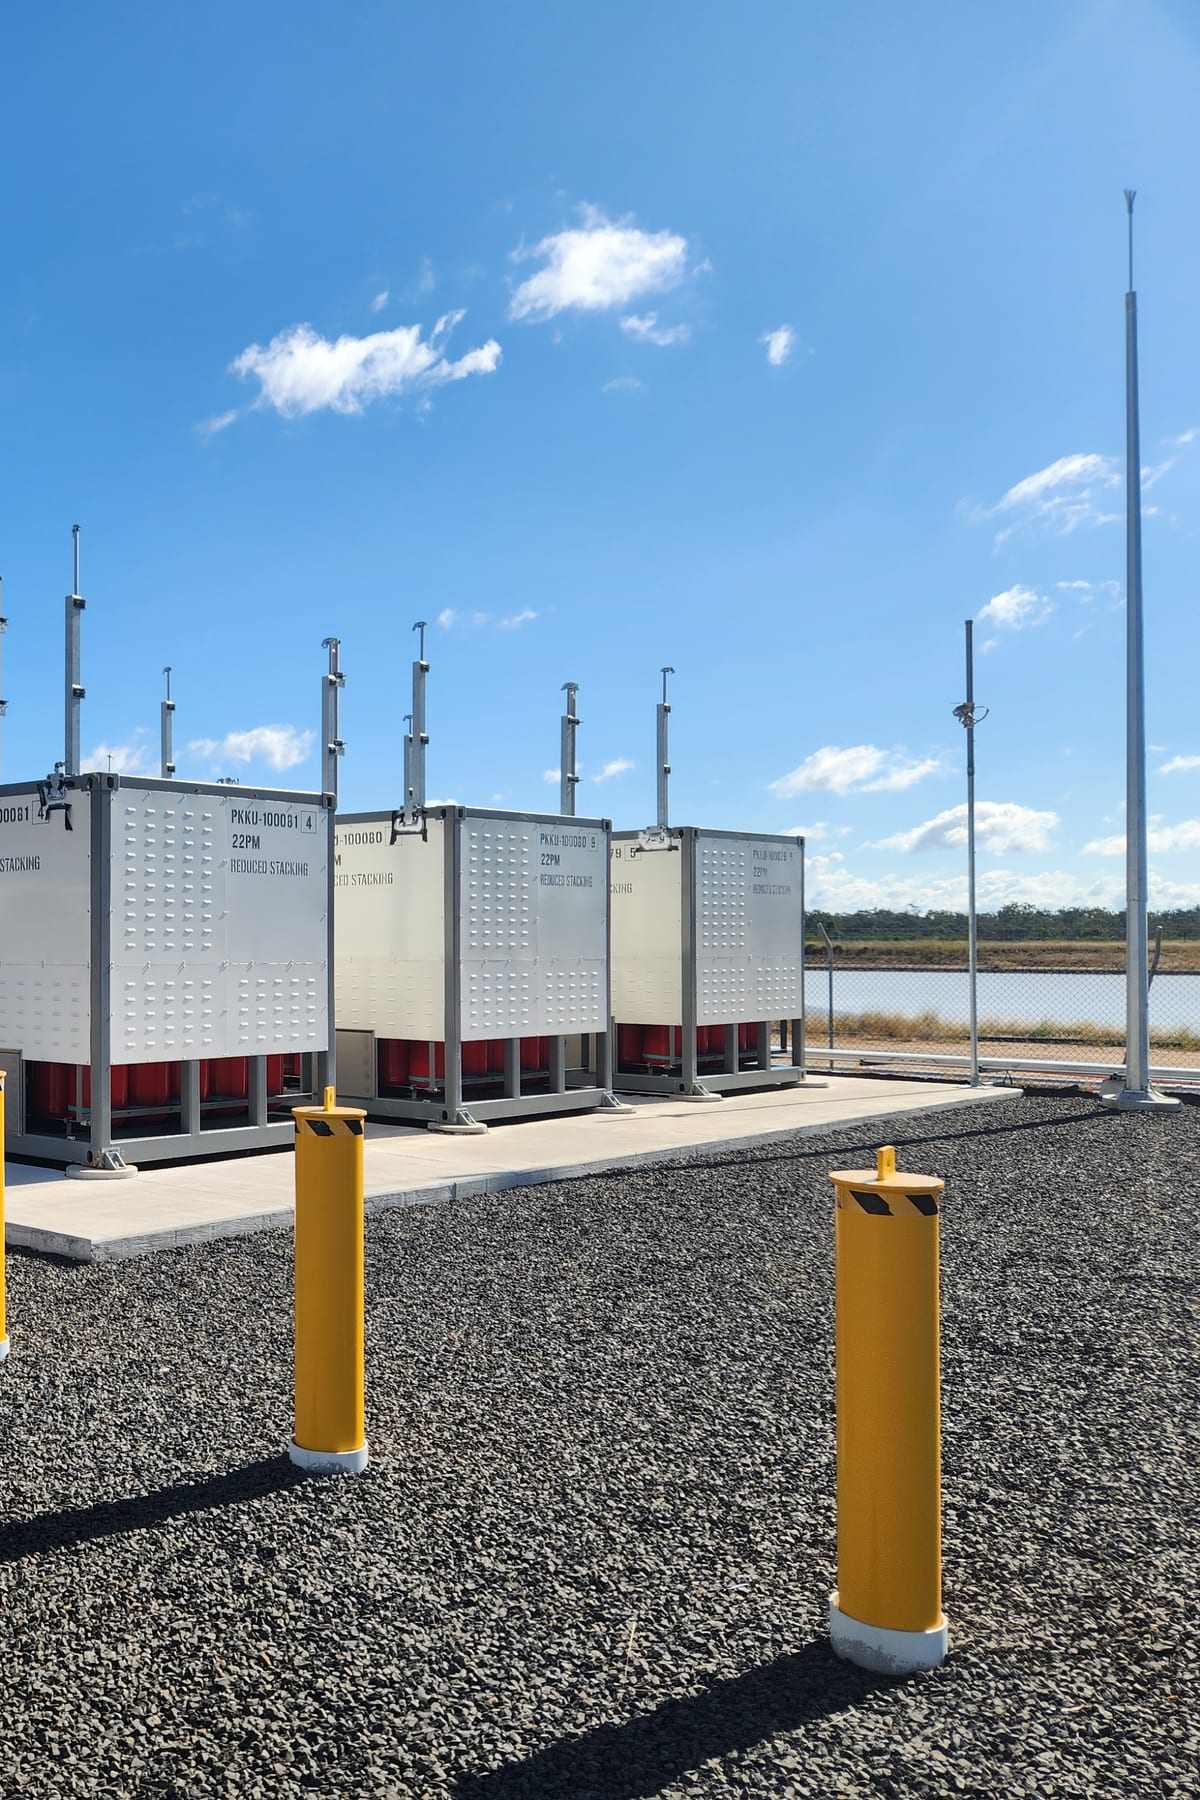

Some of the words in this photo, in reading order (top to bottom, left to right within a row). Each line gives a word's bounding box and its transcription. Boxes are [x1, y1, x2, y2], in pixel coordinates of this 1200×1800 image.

[231, 809, 298, 829] PKKU-100081
[305, 815, 312, 830] 4
[232, 833, 260, 849] 22PM
[0, 856, 40, 873] STACKING
[230, 858, 268, 873] REDUCED
[270, 860, 308, 877] STACKING
[541, 853, 560, 866] 22PM
[351, 873, 393, 886] STACKING
